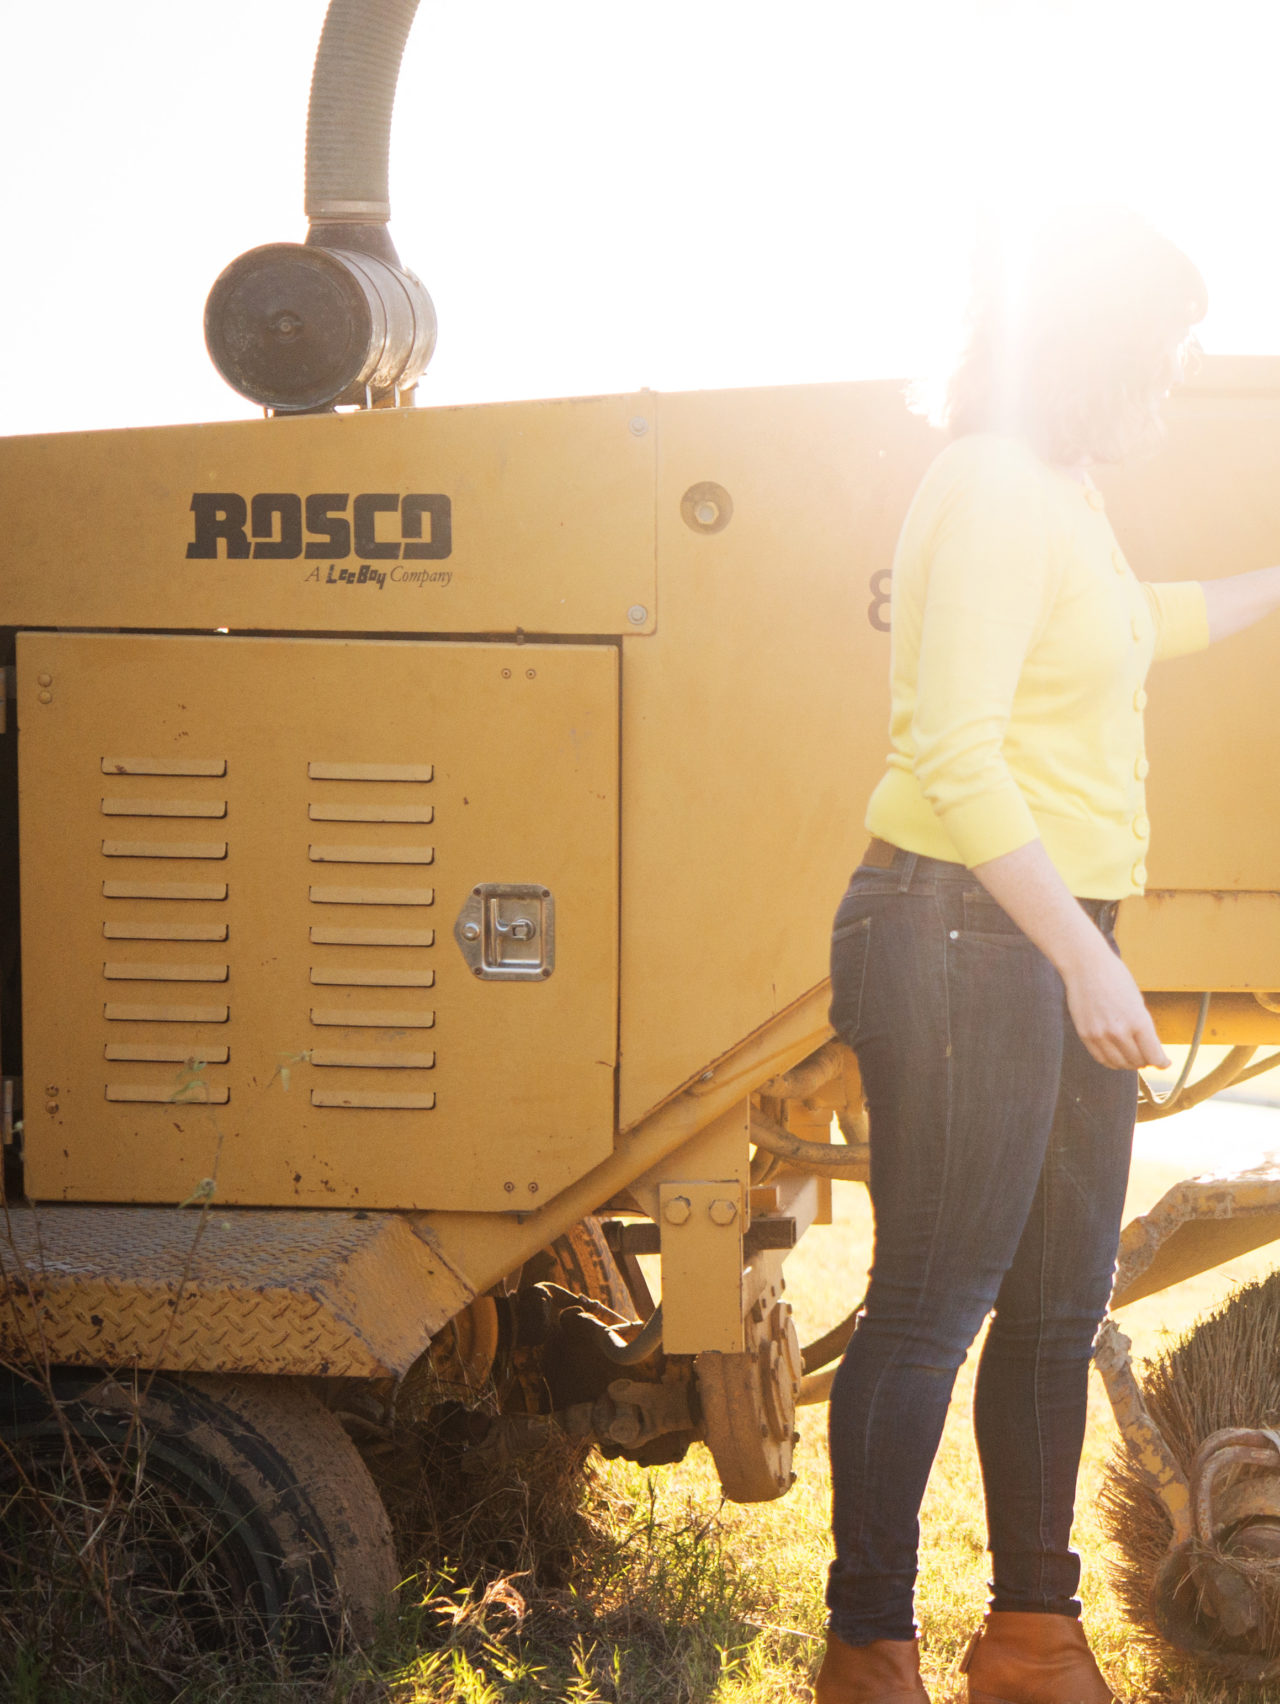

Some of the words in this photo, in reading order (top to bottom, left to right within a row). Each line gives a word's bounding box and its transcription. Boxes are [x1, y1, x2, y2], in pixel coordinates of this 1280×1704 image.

[185, 492, 453, 560] ROSCO
[304, 566, 321, 583] A
[325, 564, 387, 590] LeeBoy
[389, 565, 453, 588] Company
